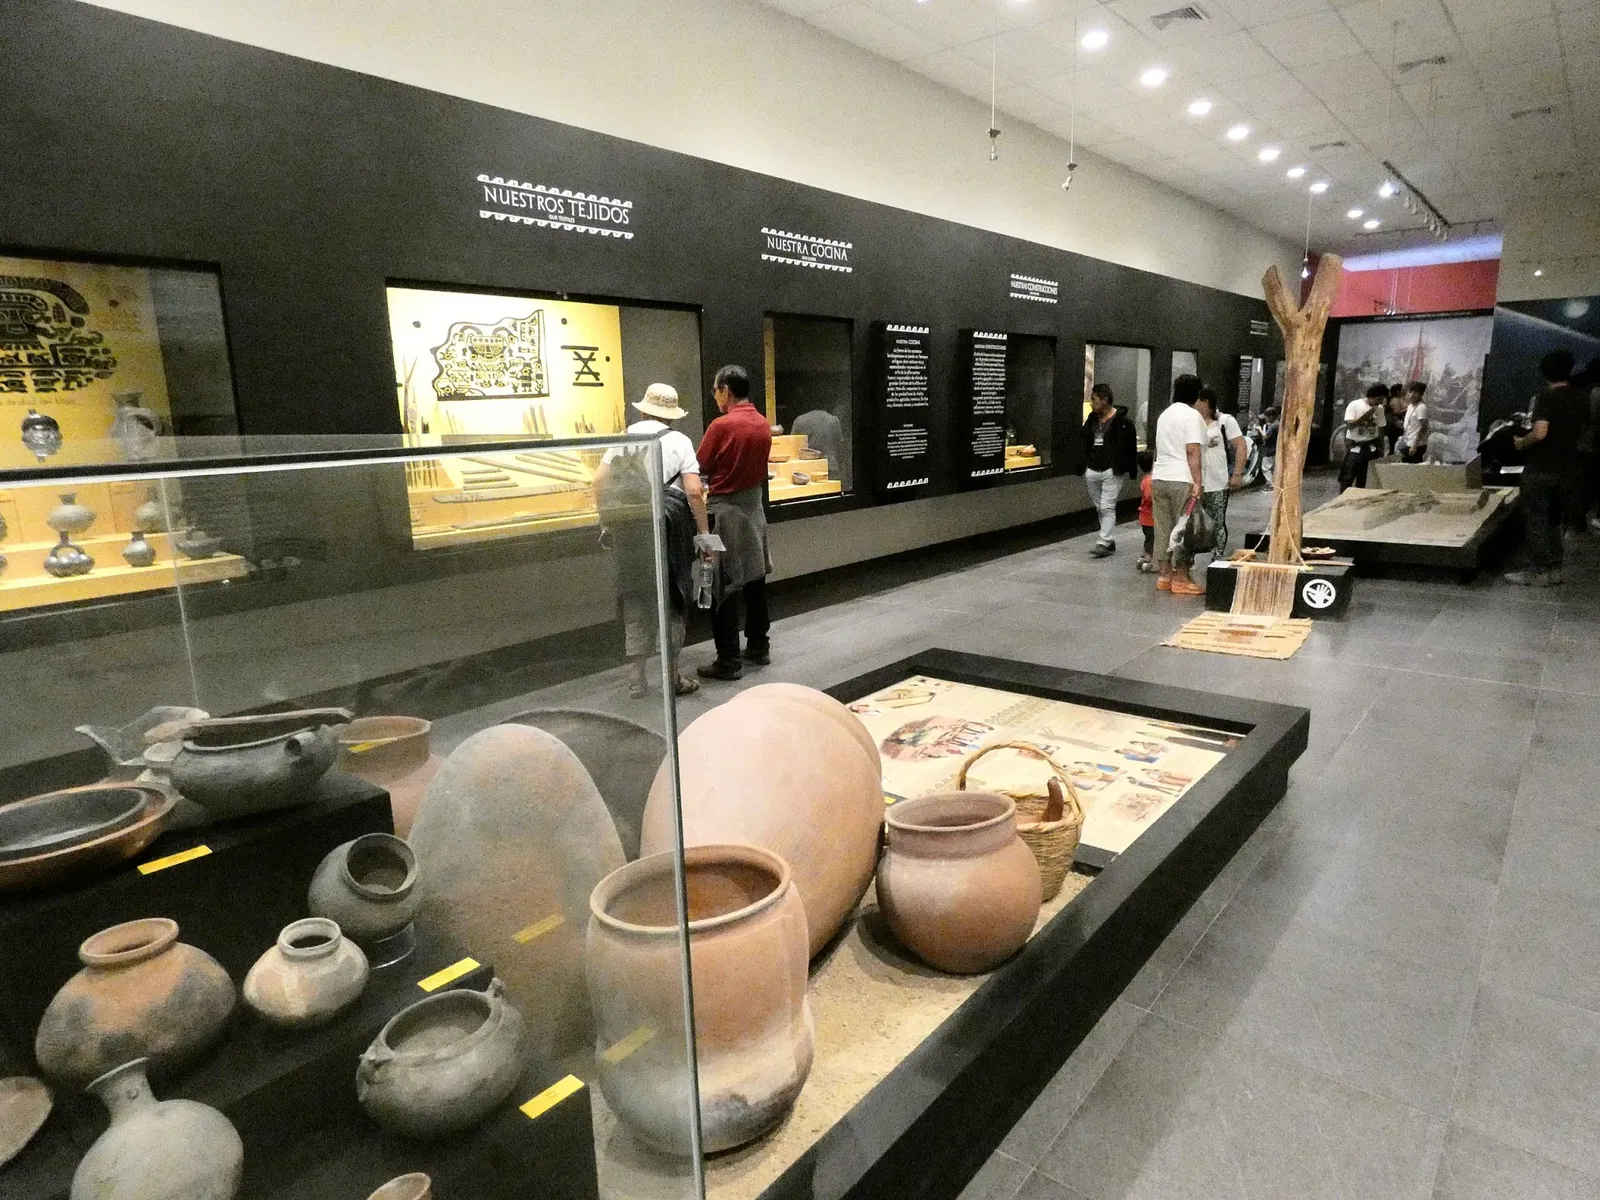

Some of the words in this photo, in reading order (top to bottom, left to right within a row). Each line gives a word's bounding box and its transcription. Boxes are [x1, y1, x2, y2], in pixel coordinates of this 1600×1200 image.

[483, 185, 564, 214] NUESTROS
[567, 199, 629, 224] TEJIDOS
[767, 235, 809, 255] NUESTRA
[810, 243, 848, 261] COCINA
